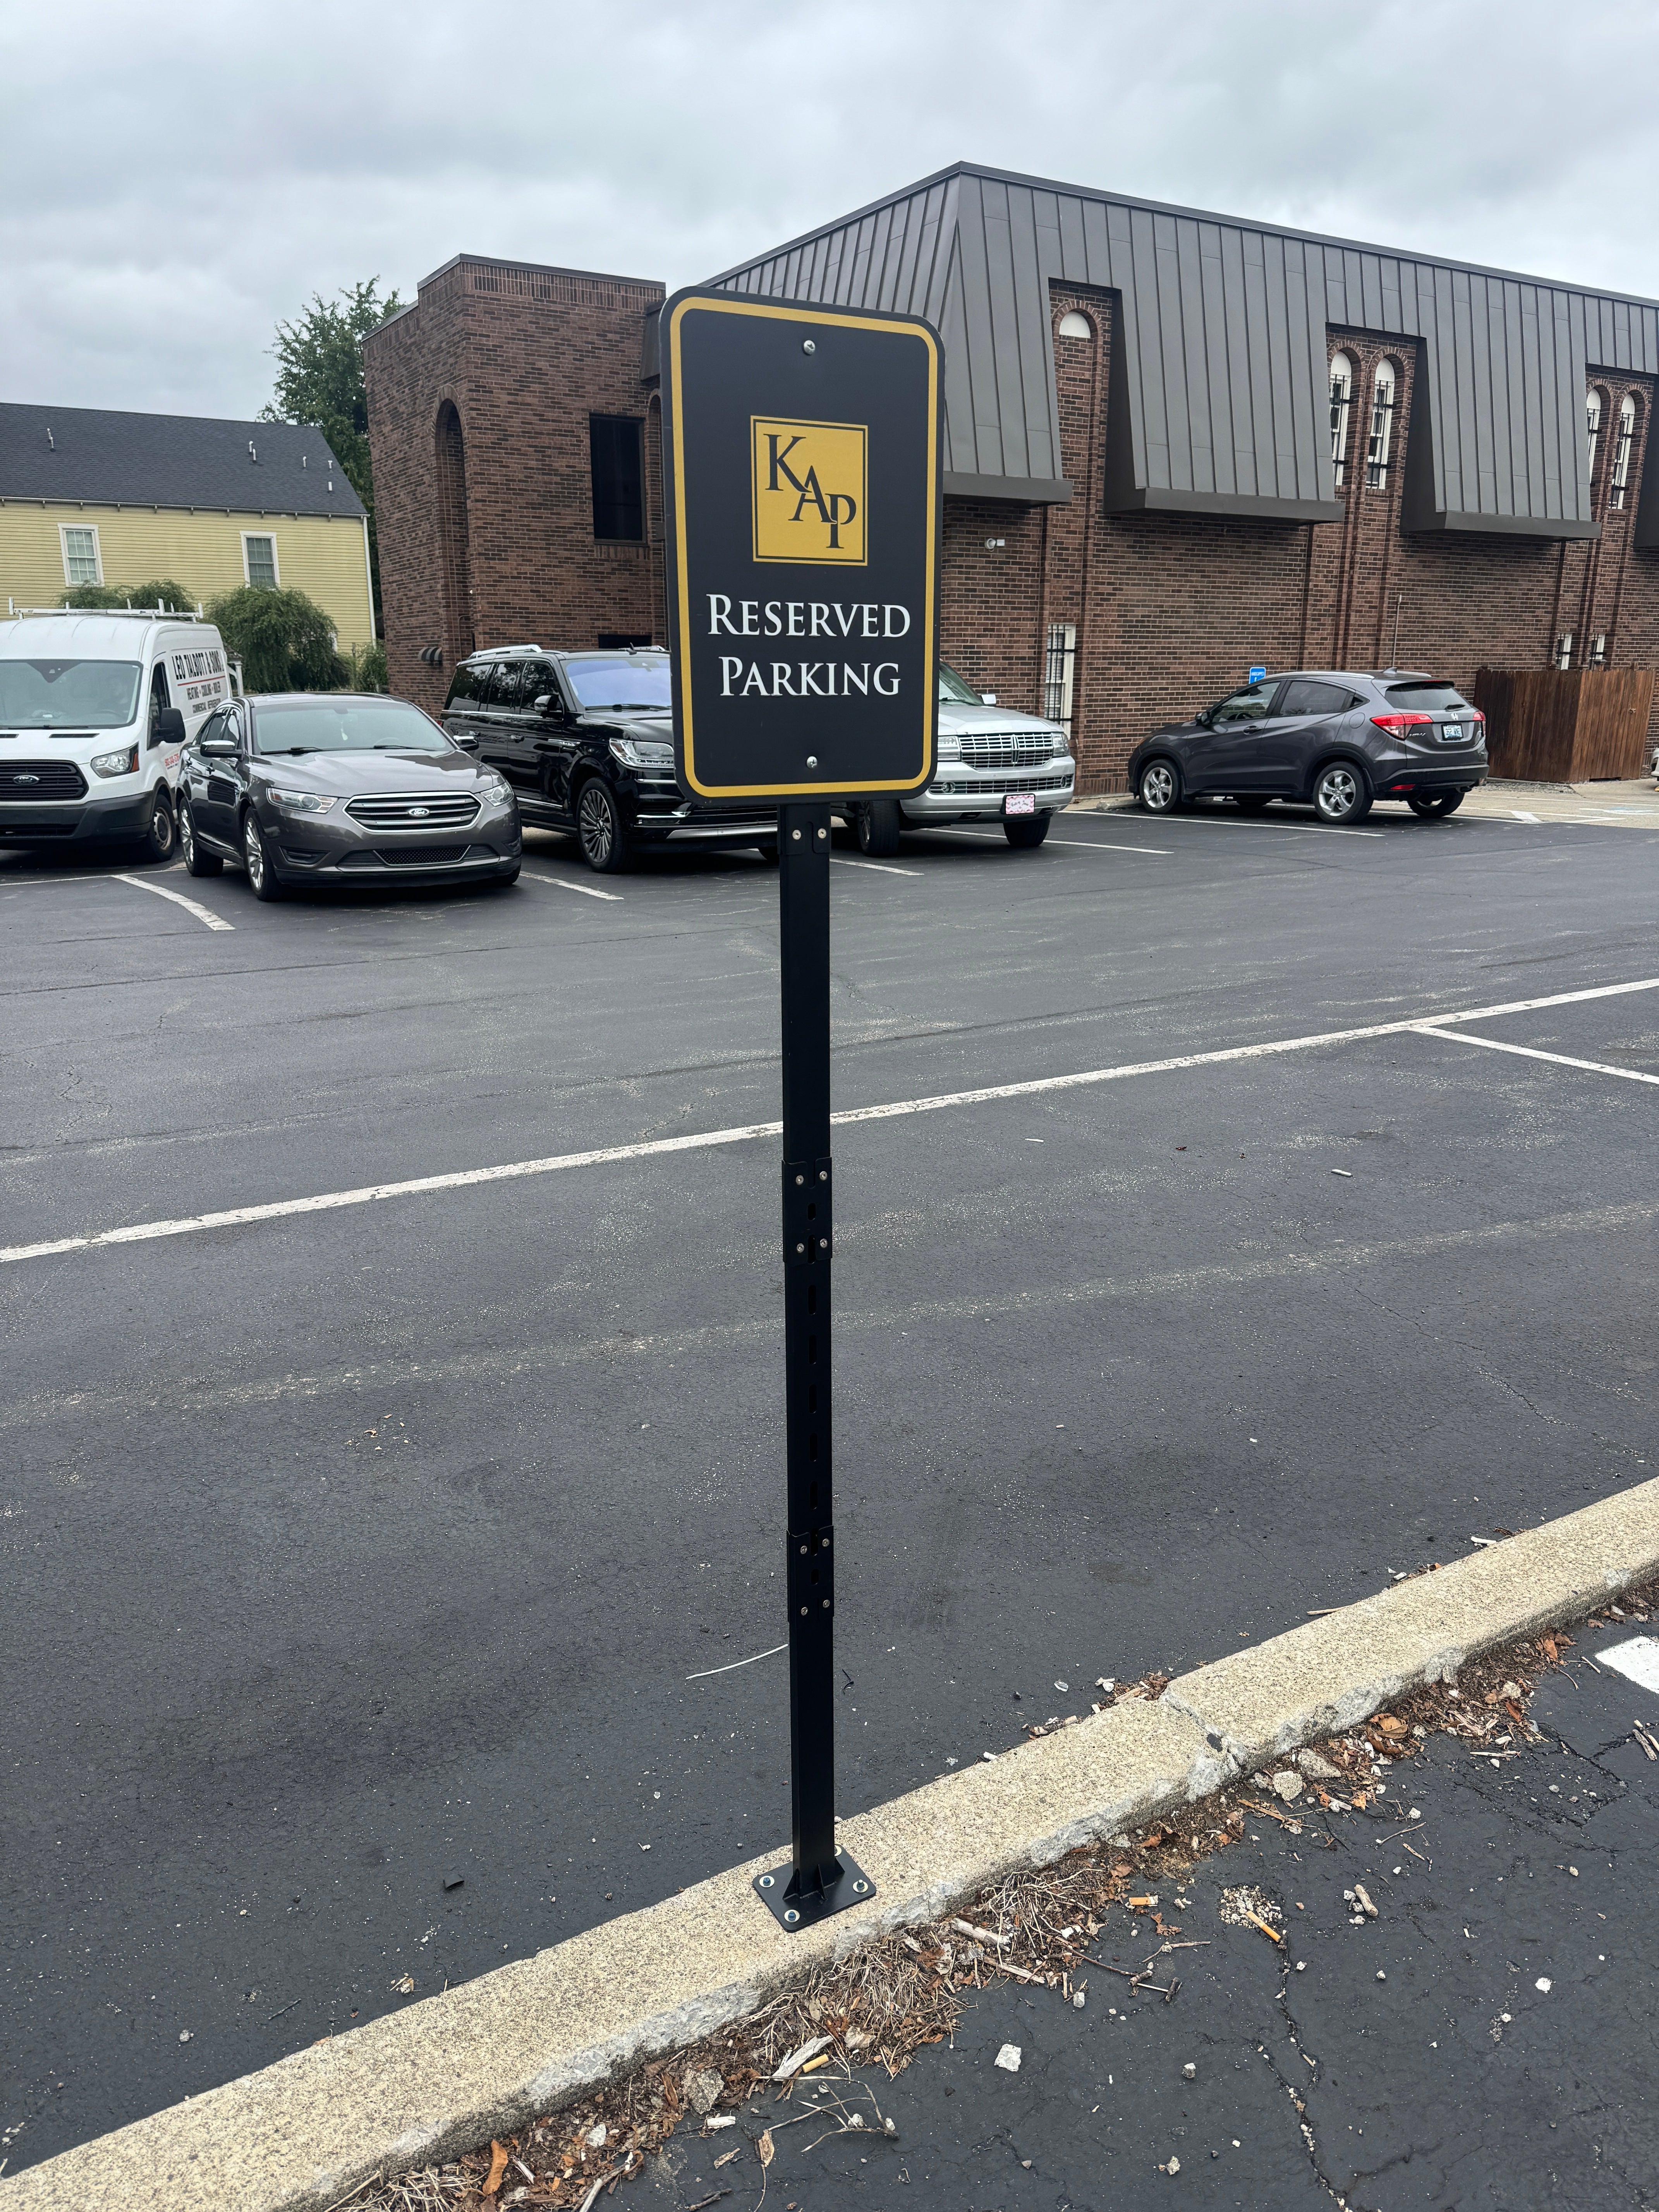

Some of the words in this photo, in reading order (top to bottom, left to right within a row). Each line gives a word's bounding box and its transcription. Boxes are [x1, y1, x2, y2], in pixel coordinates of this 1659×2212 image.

[763, 433, 857, 549] KAP
[706, 594, 910, 637] RESERVED
[172, 654, 185, 680] LEO
[184, 653, 207, 678] TALBOTT
[205, 652, 212, 674] &
[718, 656, 901, 696] PARKING
